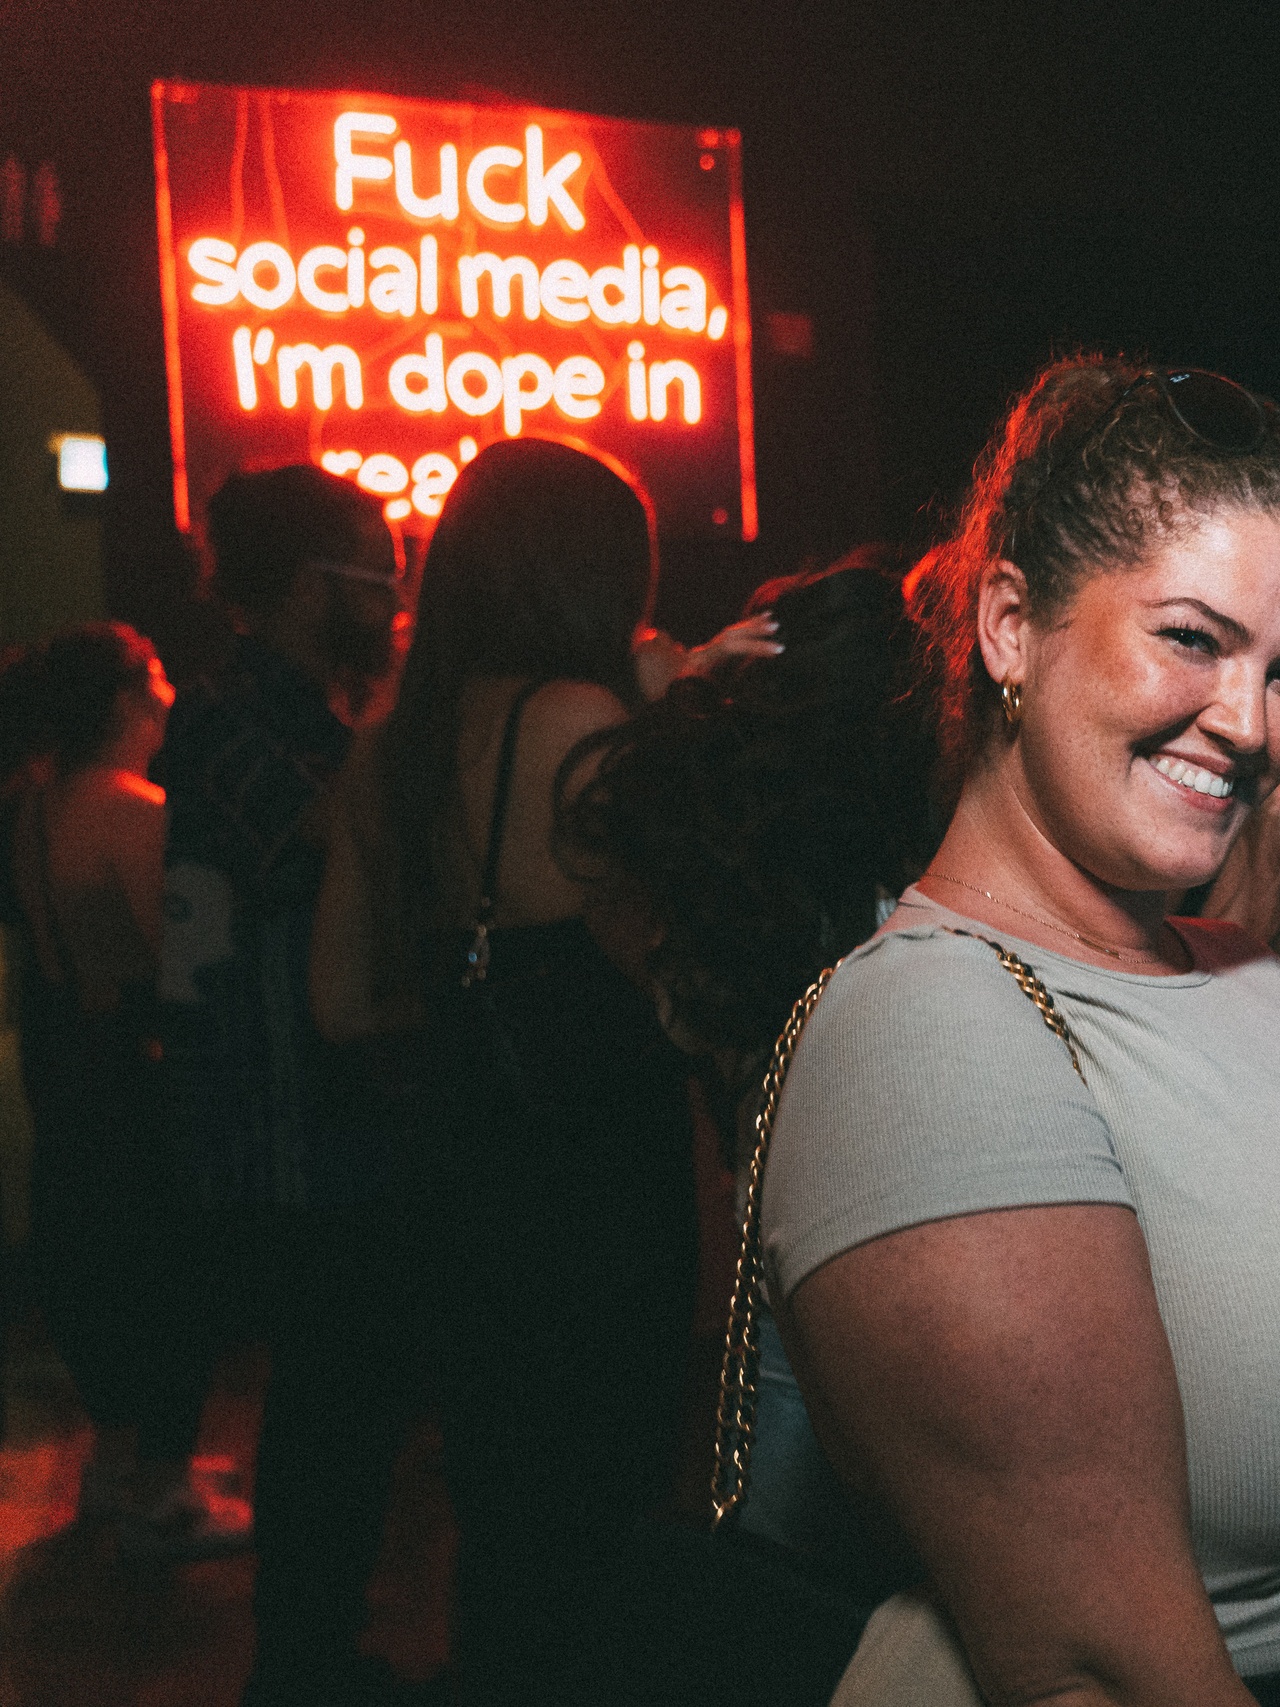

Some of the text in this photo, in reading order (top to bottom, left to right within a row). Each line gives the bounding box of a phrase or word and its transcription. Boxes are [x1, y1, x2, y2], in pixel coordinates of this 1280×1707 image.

[332, 110, 587, 232] Fuck
[186, 226, 728, 340] social media,
[231, 326, 703, 437] I'm dope in
